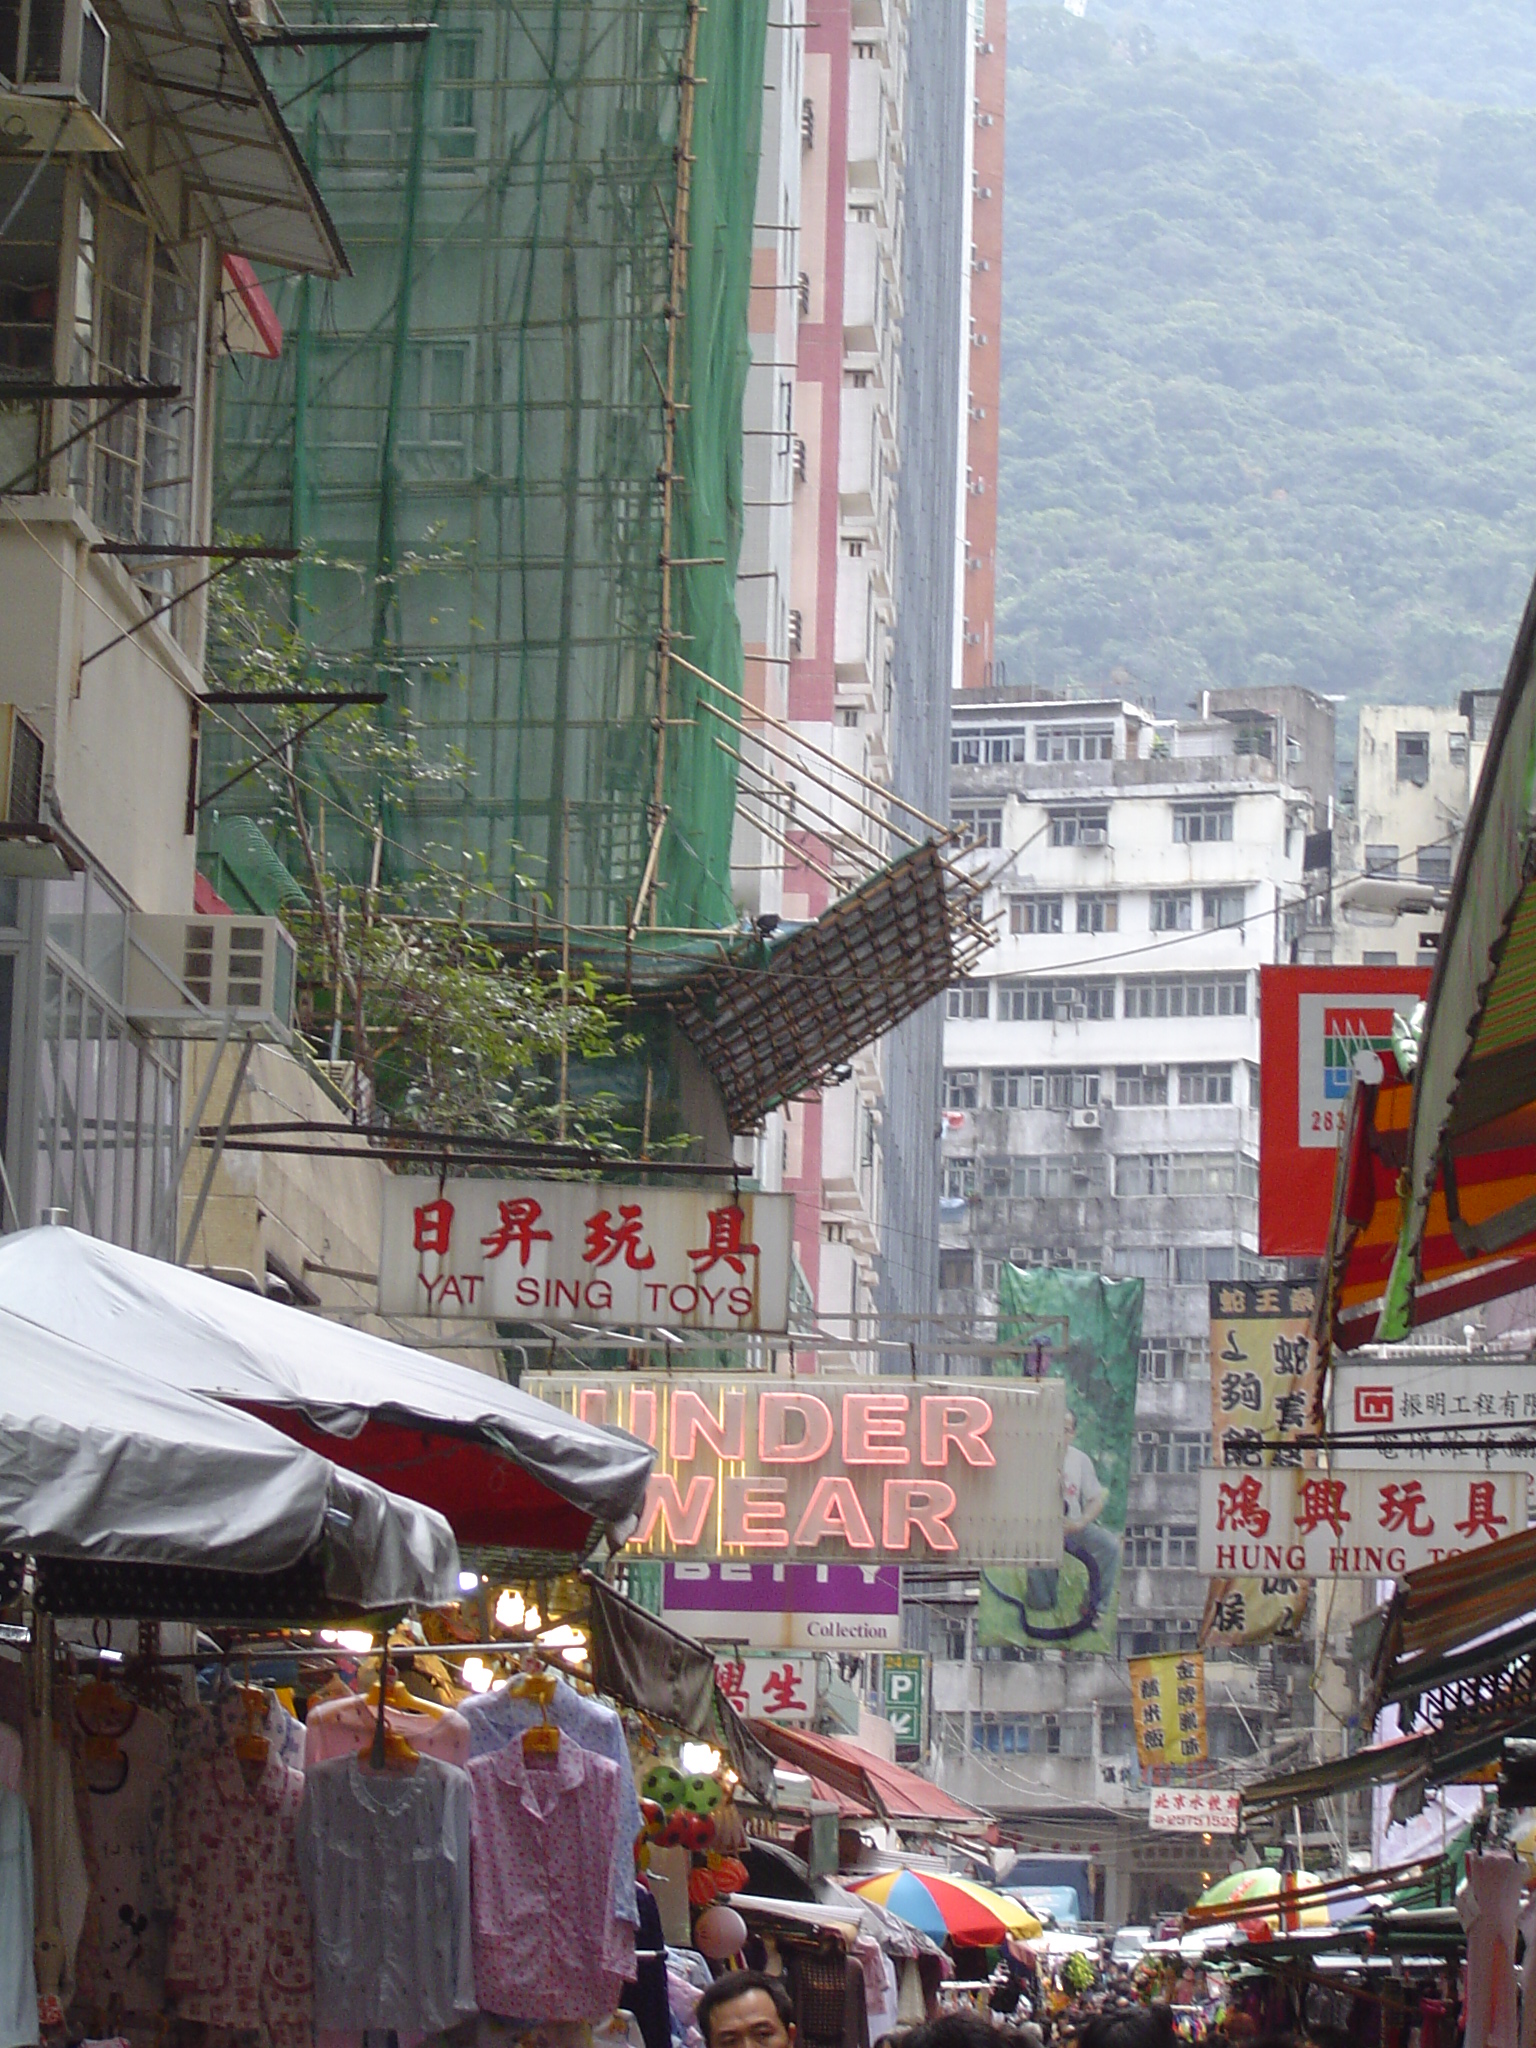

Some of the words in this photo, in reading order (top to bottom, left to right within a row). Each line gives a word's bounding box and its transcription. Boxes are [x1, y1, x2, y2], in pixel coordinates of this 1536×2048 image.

[413, 1197, 760, 1275] 日昇玩具
[418, 1274, 484, 1304] YAT
[515, 1277, 613, 1310] SING
[645, 1283, 753, 1316] TOYS
[1399, 1390, 1536, 1418] 振明工程有限
[624, 1472, 960, 1551] WEAR
[1215, 1474, 1508, 1540] 鴻興玩具
[1216, 1545, 1306, 1571] HUNG
[1329, 1547, 1406, 1573] HING
[807, 1620, 888, 1639] Collection
[891, 1674, 912, 1700] P
